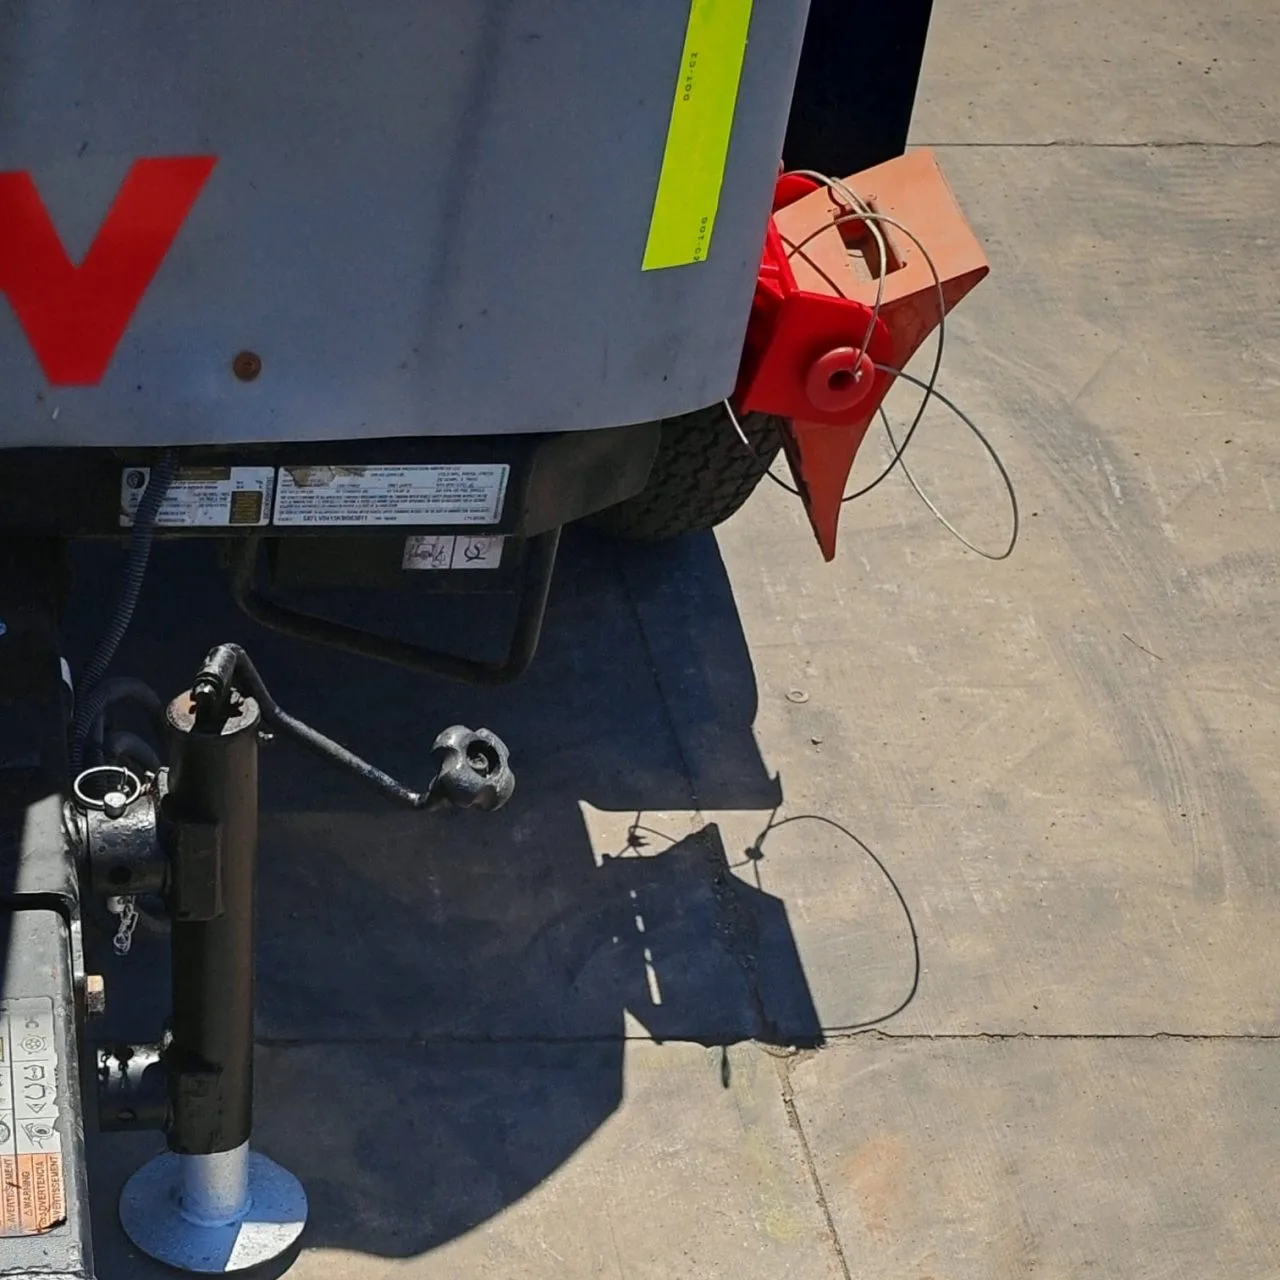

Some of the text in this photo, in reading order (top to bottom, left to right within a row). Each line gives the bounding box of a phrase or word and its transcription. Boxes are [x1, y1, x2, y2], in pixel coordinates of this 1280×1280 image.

[683, 52, 698, 101] DOT-C2
[4, 1158, 15, 1223] AVERTISSEMENT
[21, 1171, 32, 1210] WARNING
[35, 1161, 47, 1217] ADVERTENCIA
